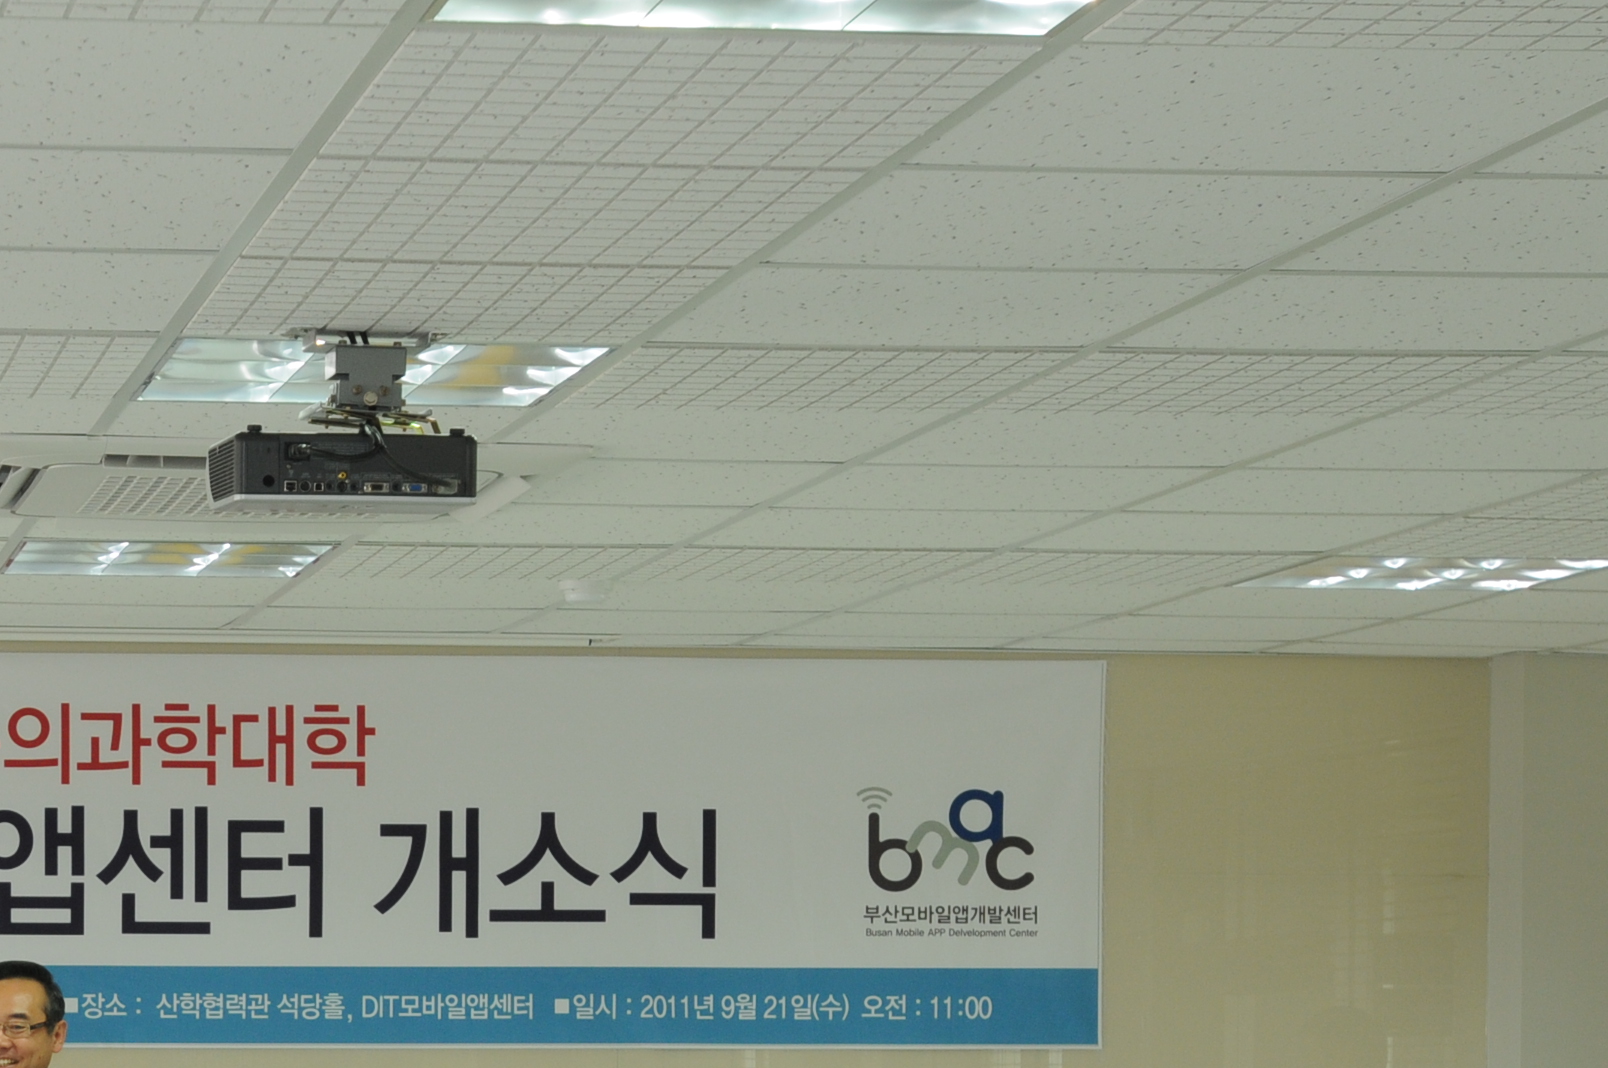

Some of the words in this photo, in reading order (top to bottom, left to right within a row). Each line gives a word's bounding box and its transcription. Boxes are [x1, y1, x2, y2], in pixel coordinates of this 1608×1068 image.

[374, 808, 716, 939] 개소식
[864, 905, 1037, 924] 부산모바일앱개발센터
[866, 928, 892, 936] Busan
[928, 928, 945, 936] APP
[1009, 928, 1038, 937] Center
[156, 993, 270, 1019] 산학협력관
[277, 993, 352, 1023] 석당홀,
[362, 994, 533, 1019] DIT모바일앱센터
[640, 994, 713, 1019] 2011년
[721, 994, 756, 1020] 9월
[764, 994, 849, 1020] 21일(수)
[931, 996, 992, 1019] 11:00
